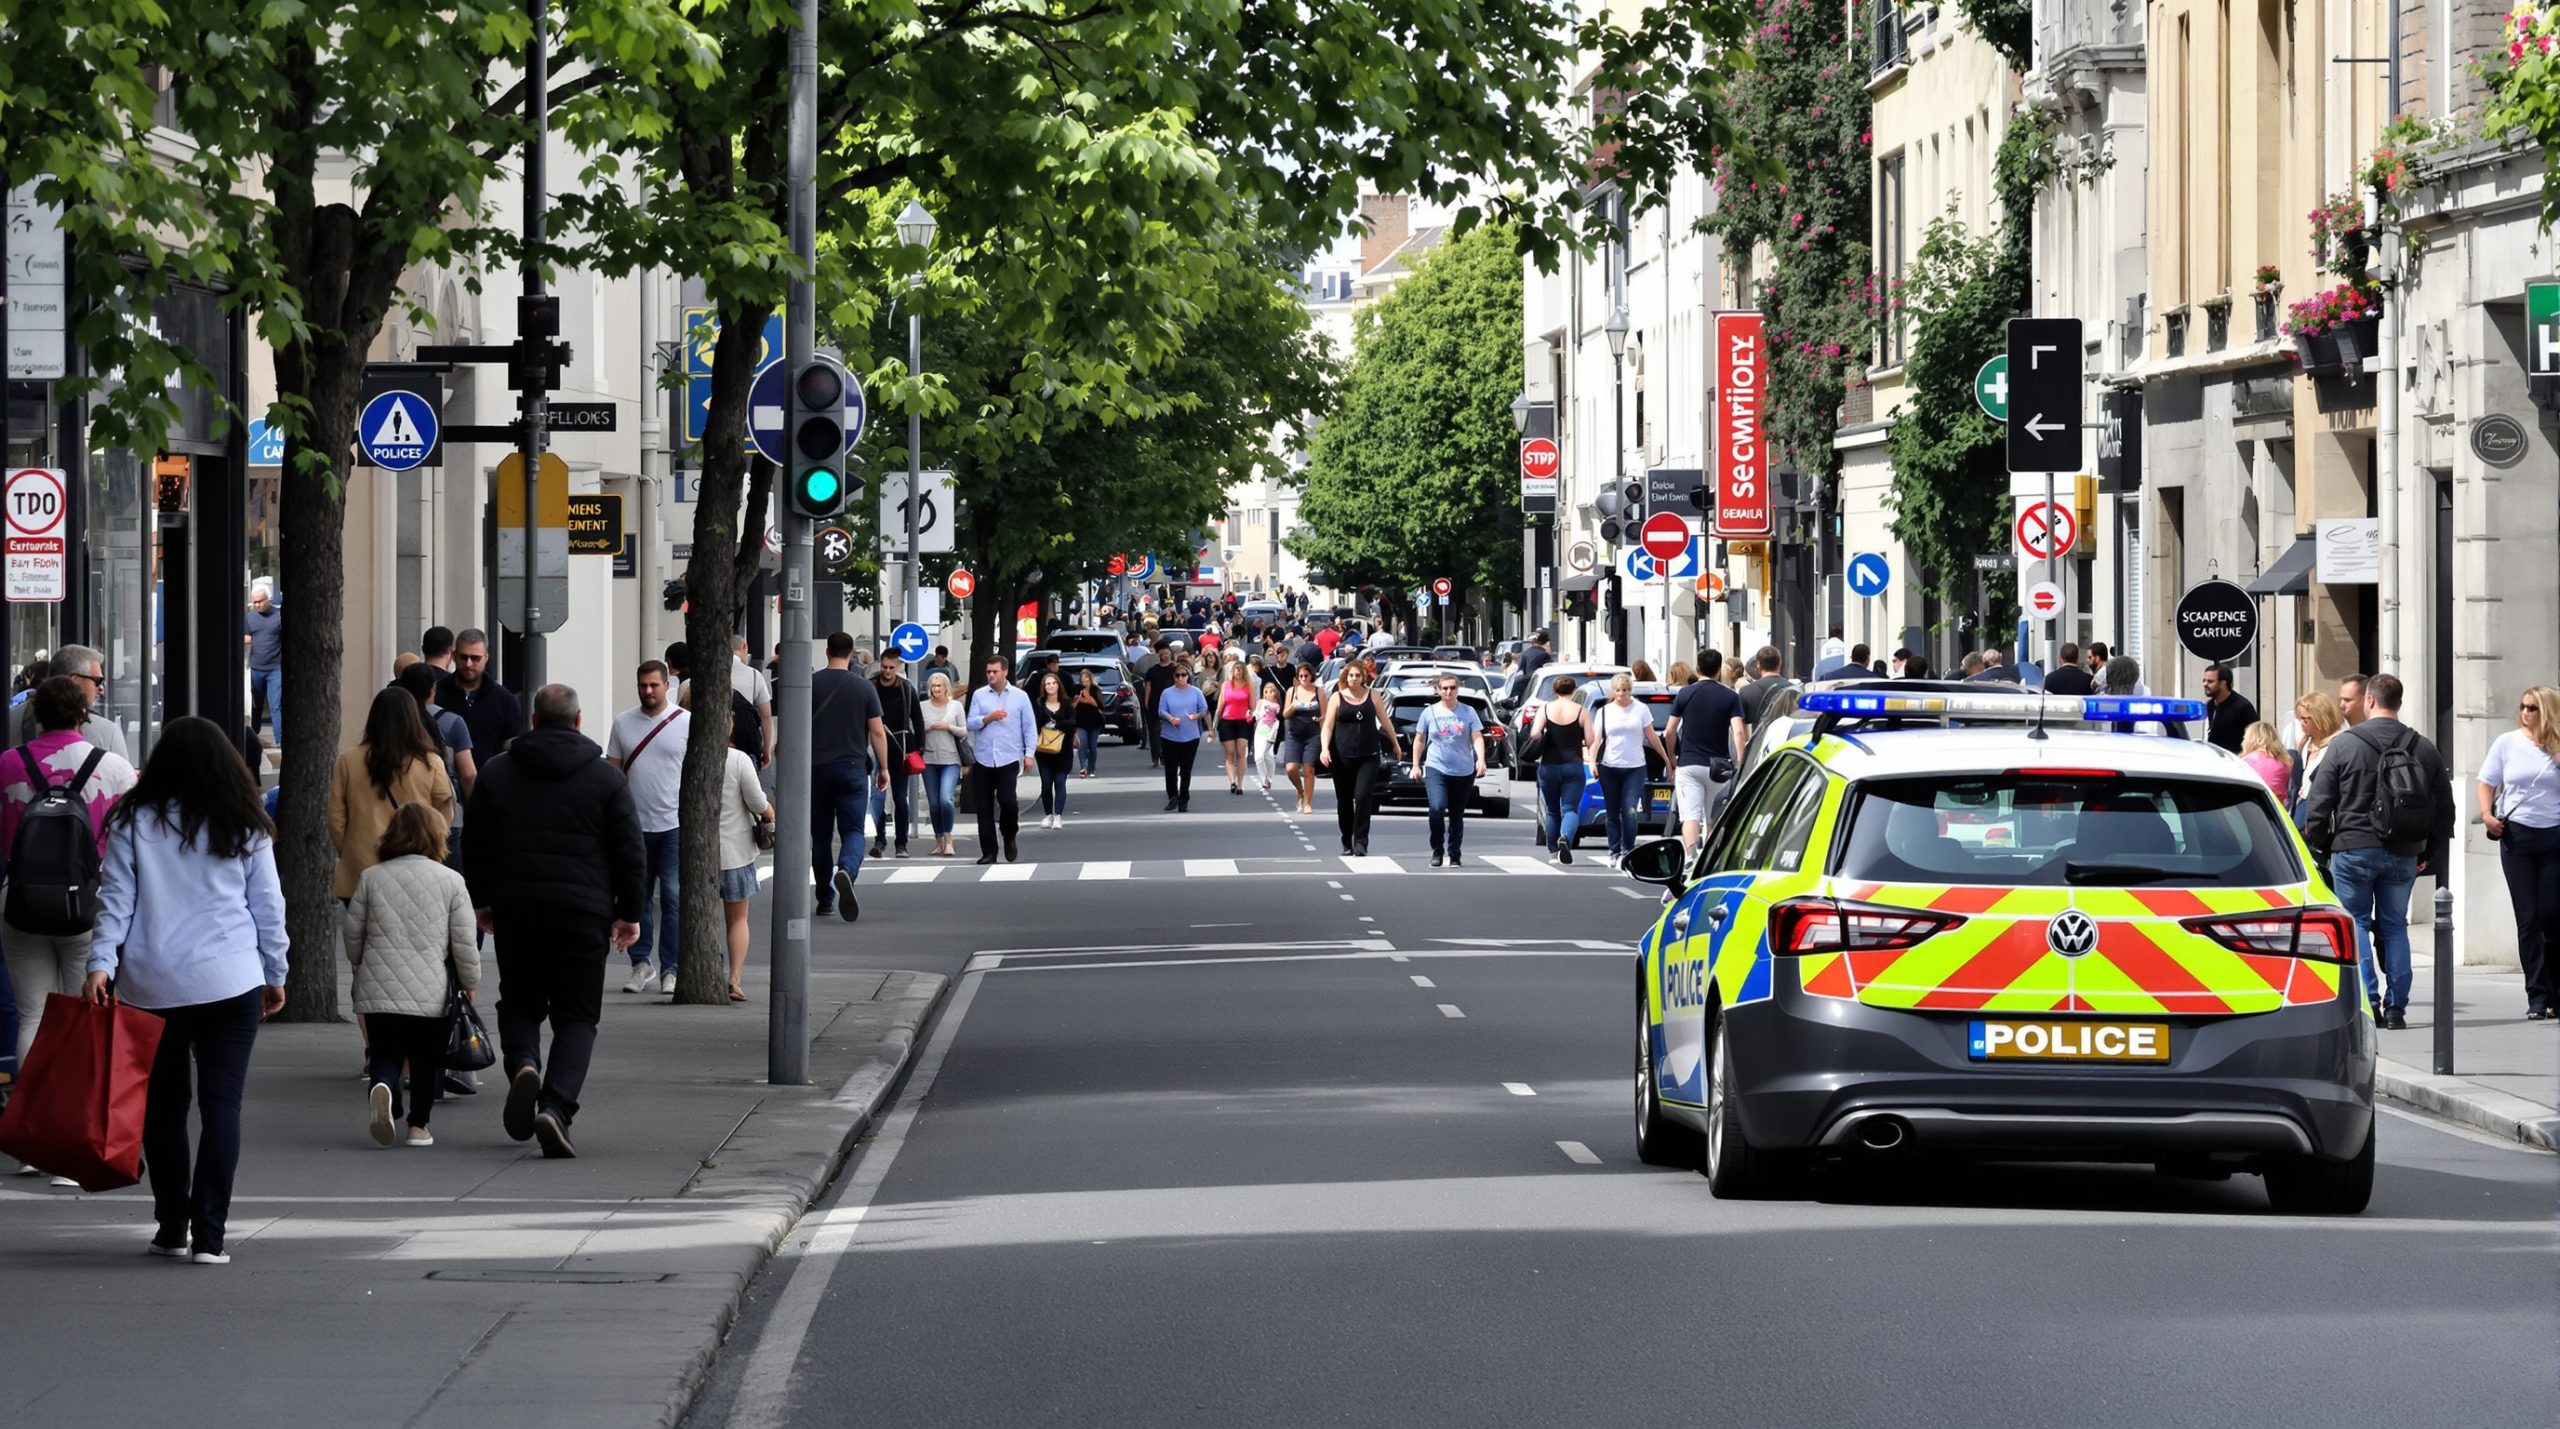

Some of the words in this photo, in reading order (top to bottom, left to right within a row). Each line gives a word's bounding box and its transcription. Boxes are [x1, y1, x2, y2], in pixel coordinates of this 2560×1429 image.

[13, 492, 56, 515] TDO
[1667, 959, 1704, 1009] POLICE
[1984, 1023, 2158, 1056] POLICE
